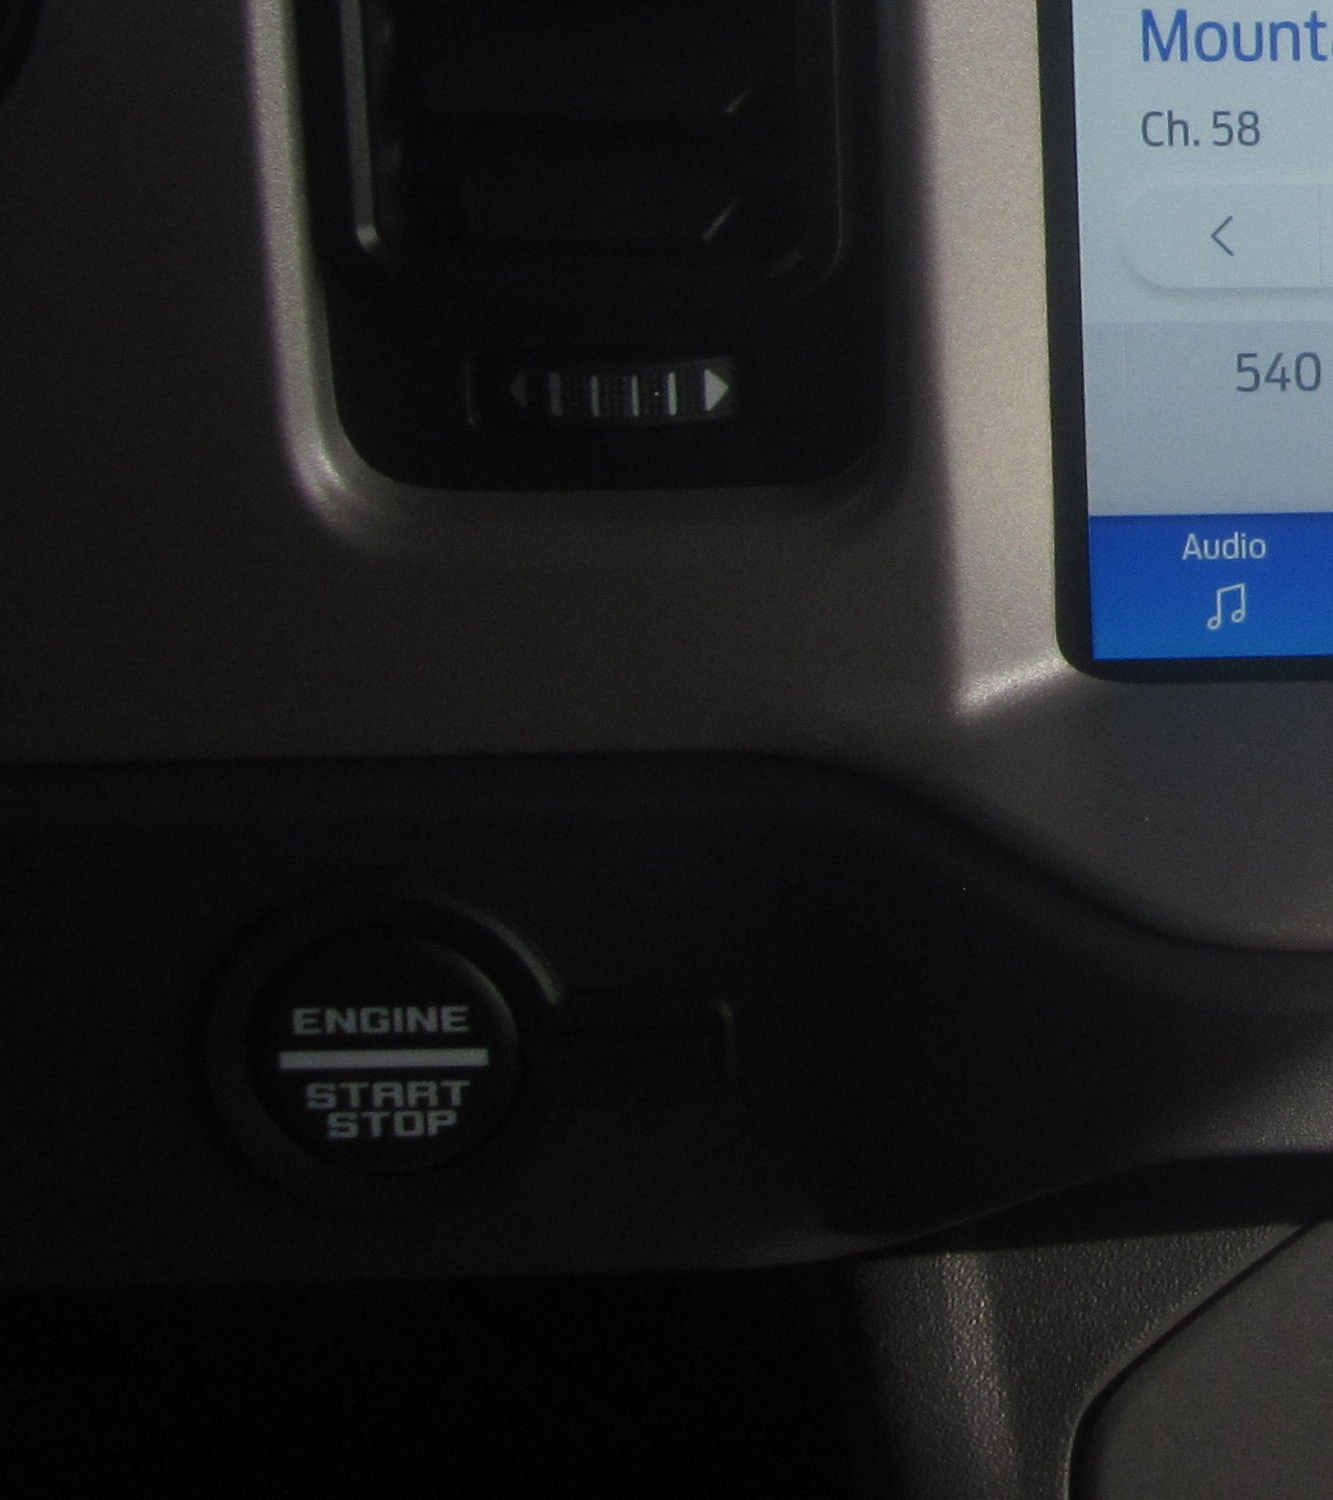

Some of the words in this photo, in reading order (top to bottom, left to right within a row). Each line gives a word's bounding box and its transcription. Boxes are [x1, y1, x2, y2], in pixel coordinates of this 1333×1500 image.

[1140, 109, 1201, 148] Ch.
[1211, 109, 1261, 147] 58
[1235, 351, 1323, 393] 540
[1181, 531, 1268, 562] Audio
[293, 1005, 470, 1035] ENGINE
[306, 1080, 471, 1110] START
[328, 1111, 457, 1139] STOP
